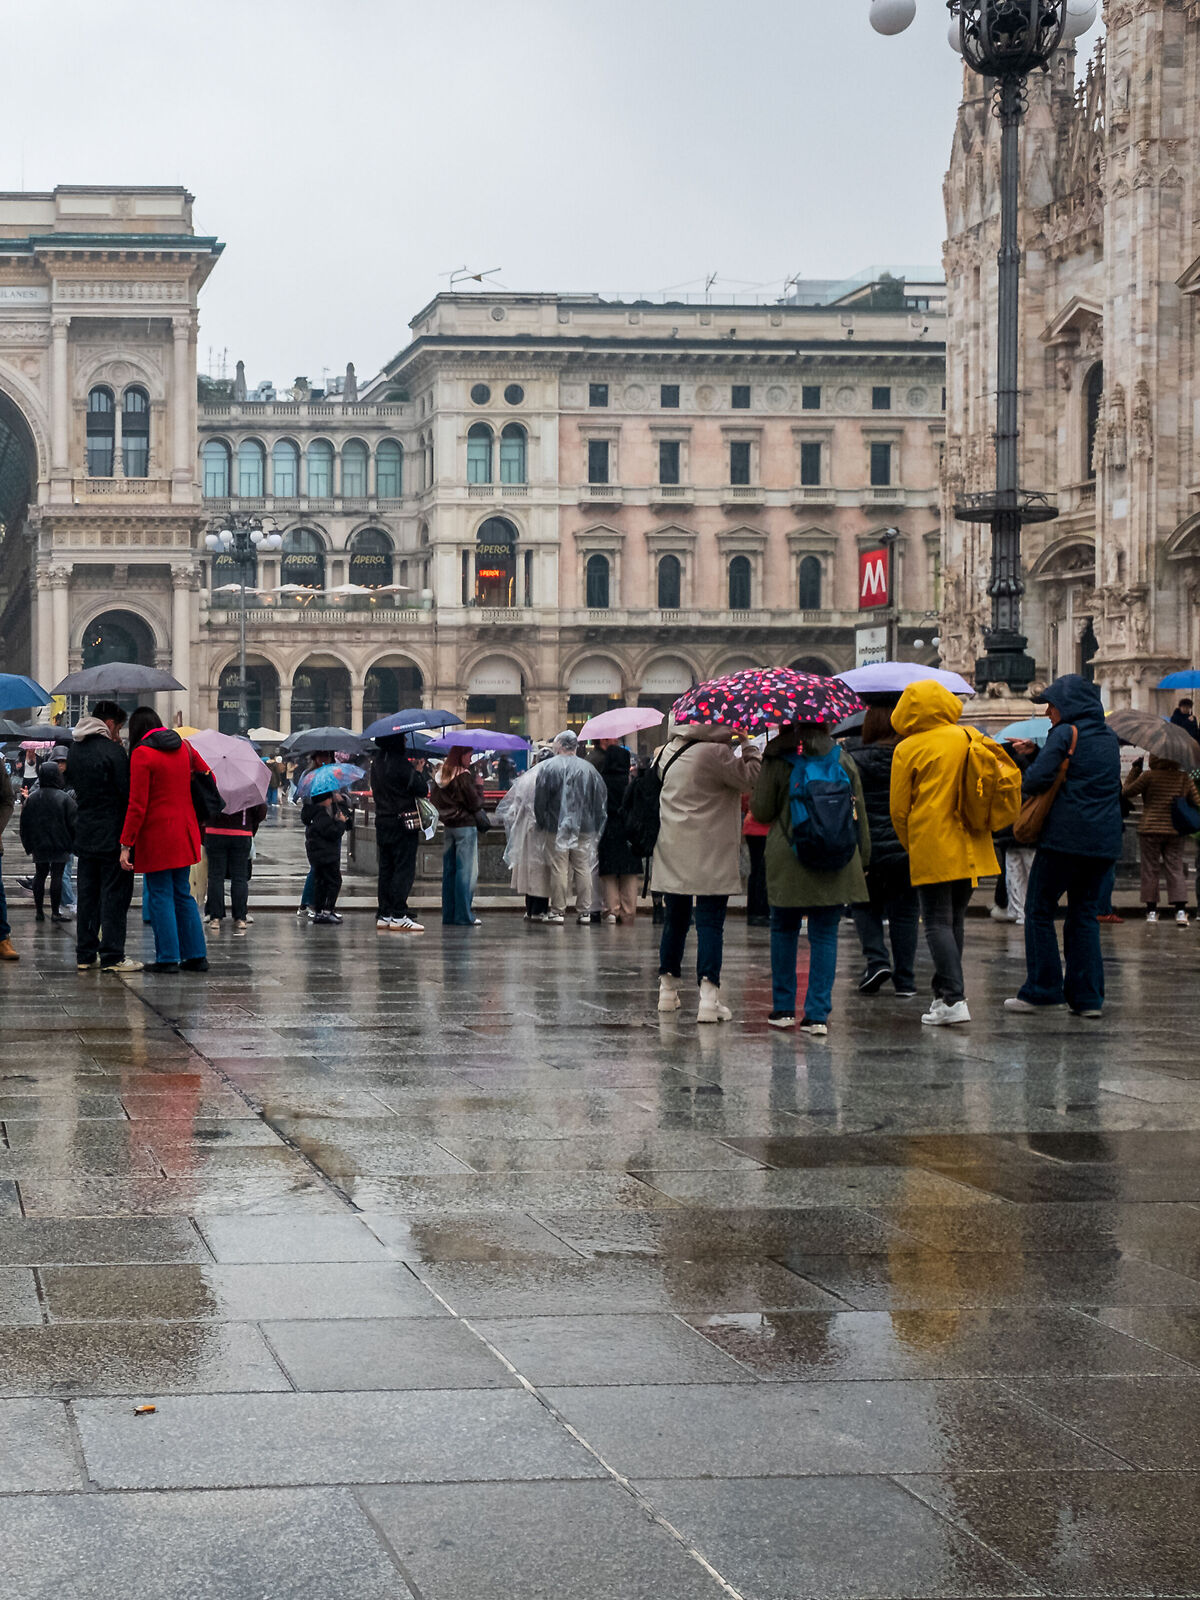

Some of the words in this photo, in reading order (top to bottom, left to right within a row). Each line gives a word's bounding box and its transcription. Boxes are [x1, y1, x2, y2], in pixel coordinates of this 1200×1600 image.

[284, 555, 318, 564] APEROL
[352, 555, 386, 564] APEROL
[861, 559, 887, 597] M
